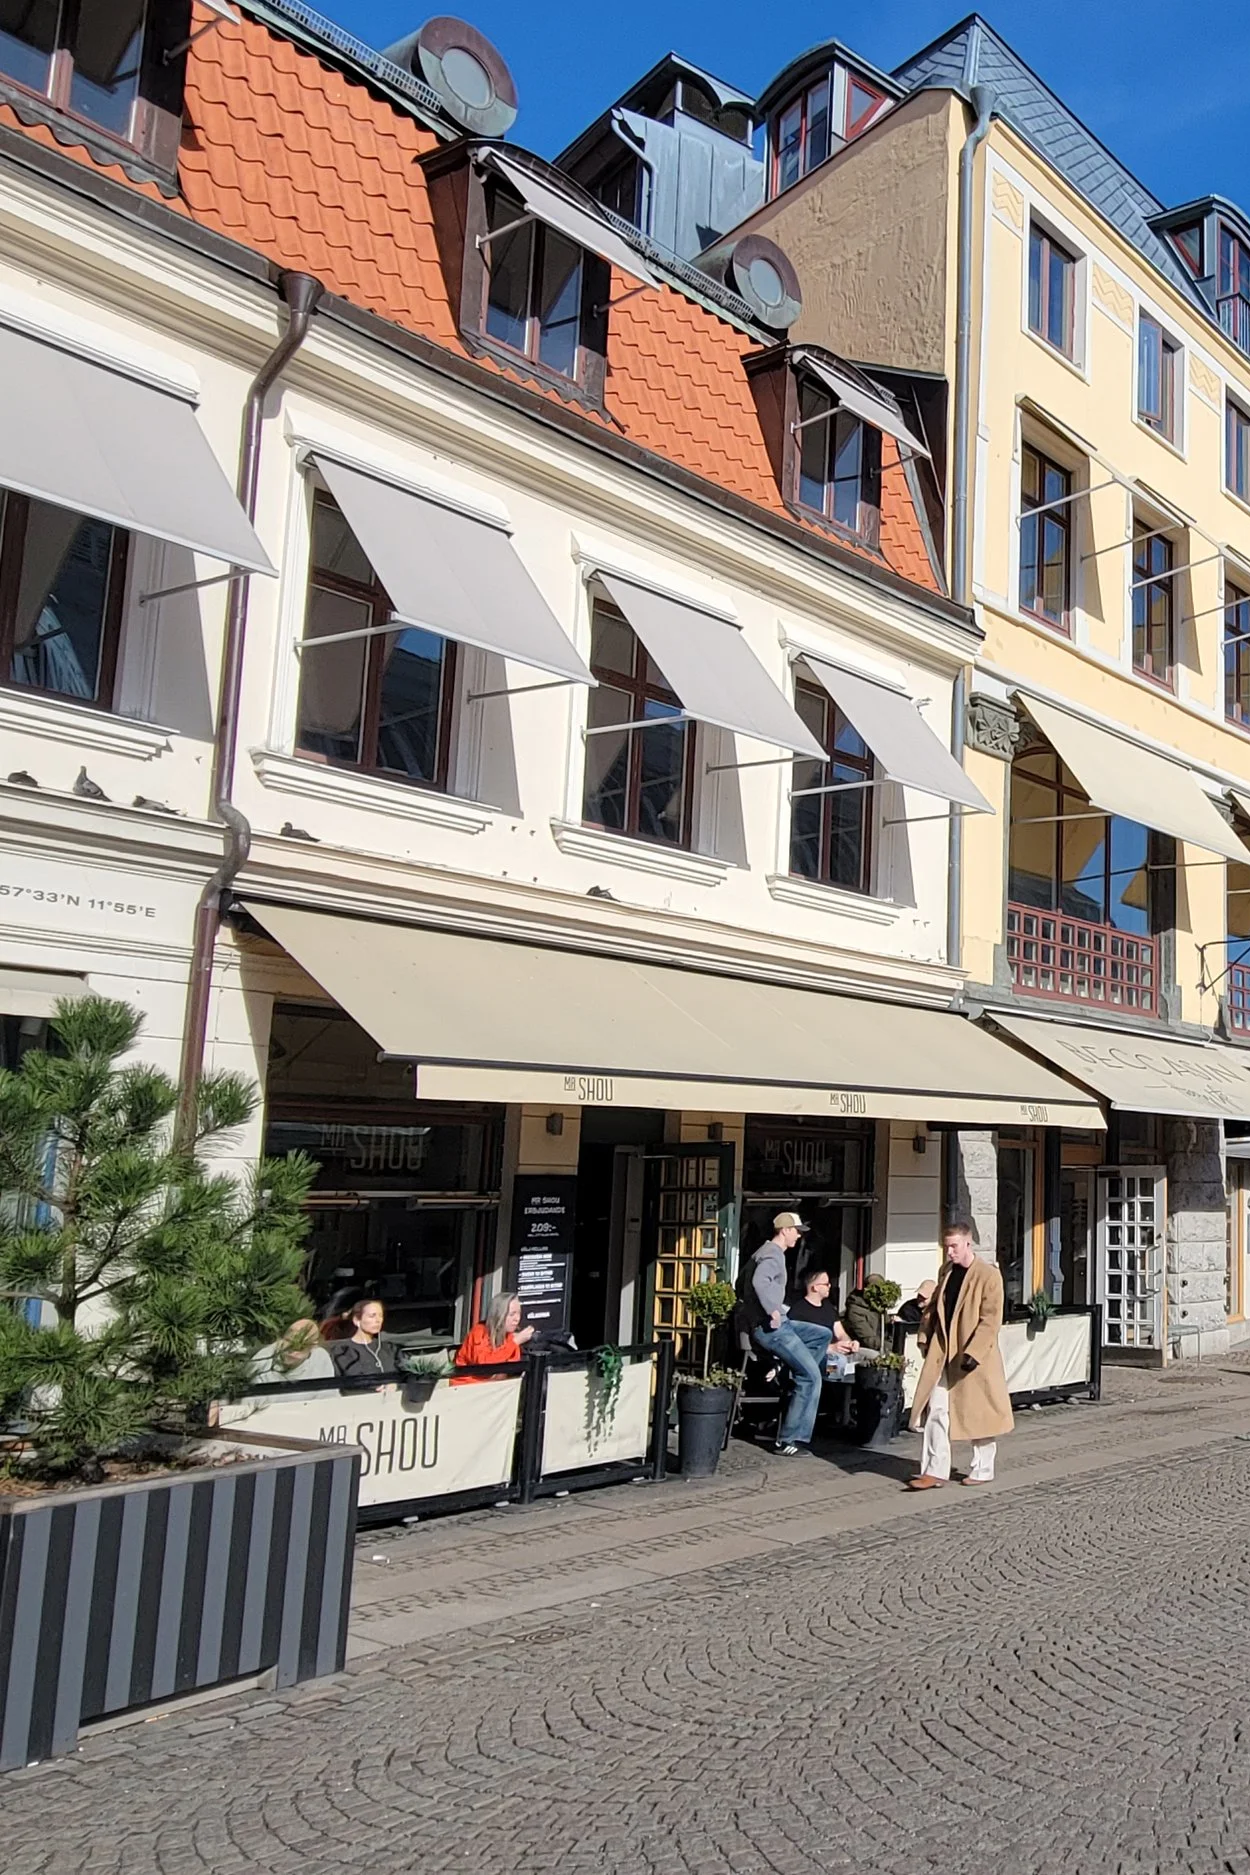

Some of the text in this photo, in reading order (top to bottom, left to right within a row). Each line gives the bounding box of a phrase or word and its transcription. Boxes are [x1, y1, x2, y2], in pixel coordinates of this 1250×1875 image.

[1055, 1038, 1246, 1083] BECCASIN
[578, 1077, 613, 1102] SHOU
[840, 1093, 866, 1114] SHOU
[1028, 1105, 1048, 1122] SHOU
[783, 1140, 825, 1177] SHOU
[356, 1415, 439, 1477] SHOU
